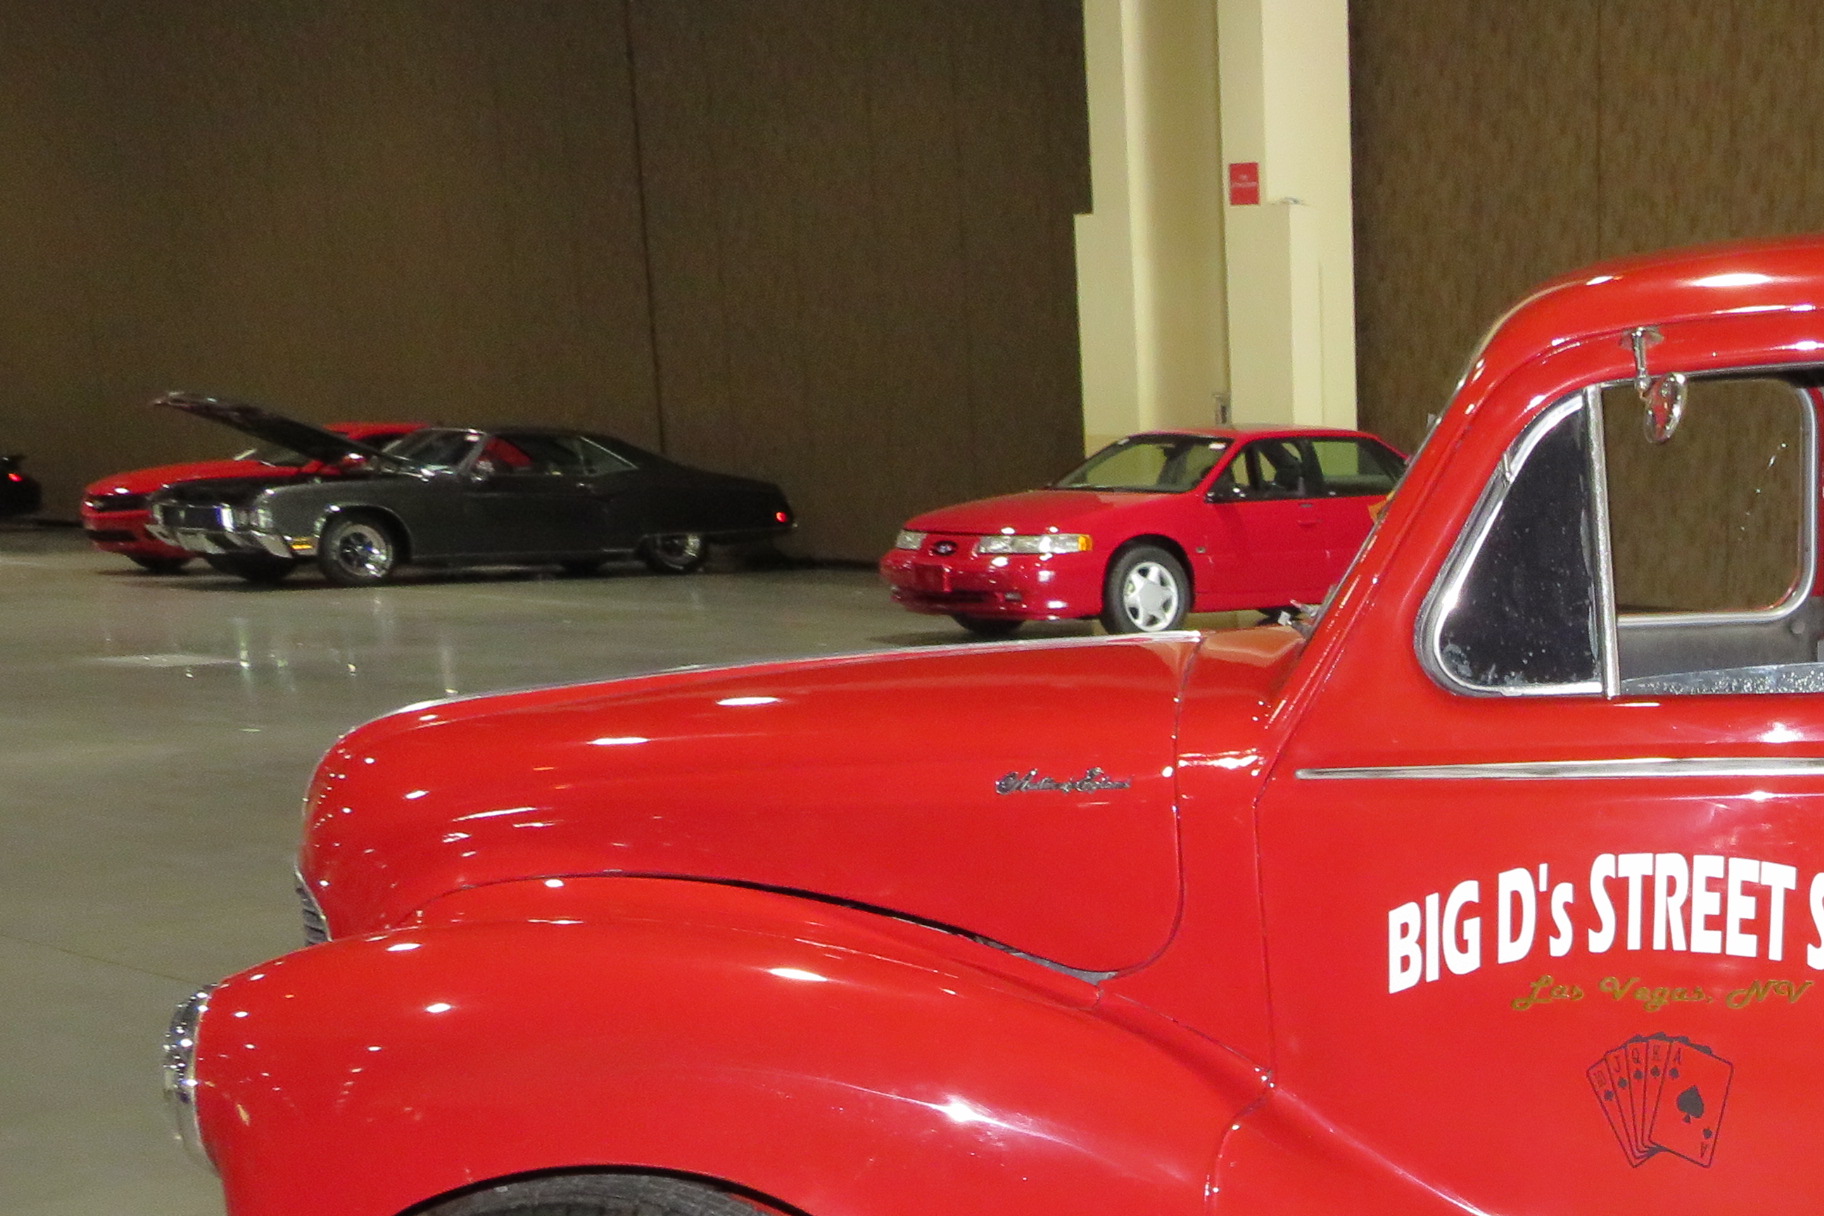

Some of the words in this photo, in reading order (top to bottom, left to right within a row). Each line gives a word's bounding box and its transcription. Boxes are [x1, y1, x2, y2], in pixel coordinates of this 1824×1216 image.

[1388, 879, 1481, 994] BIG
[1497, 863, 1574, 965] D's
[1588, 852, 1797, 961] STREET
[1511, 975, 1584, 1010] Las
[1725, 980, 1814, 1009] NV
